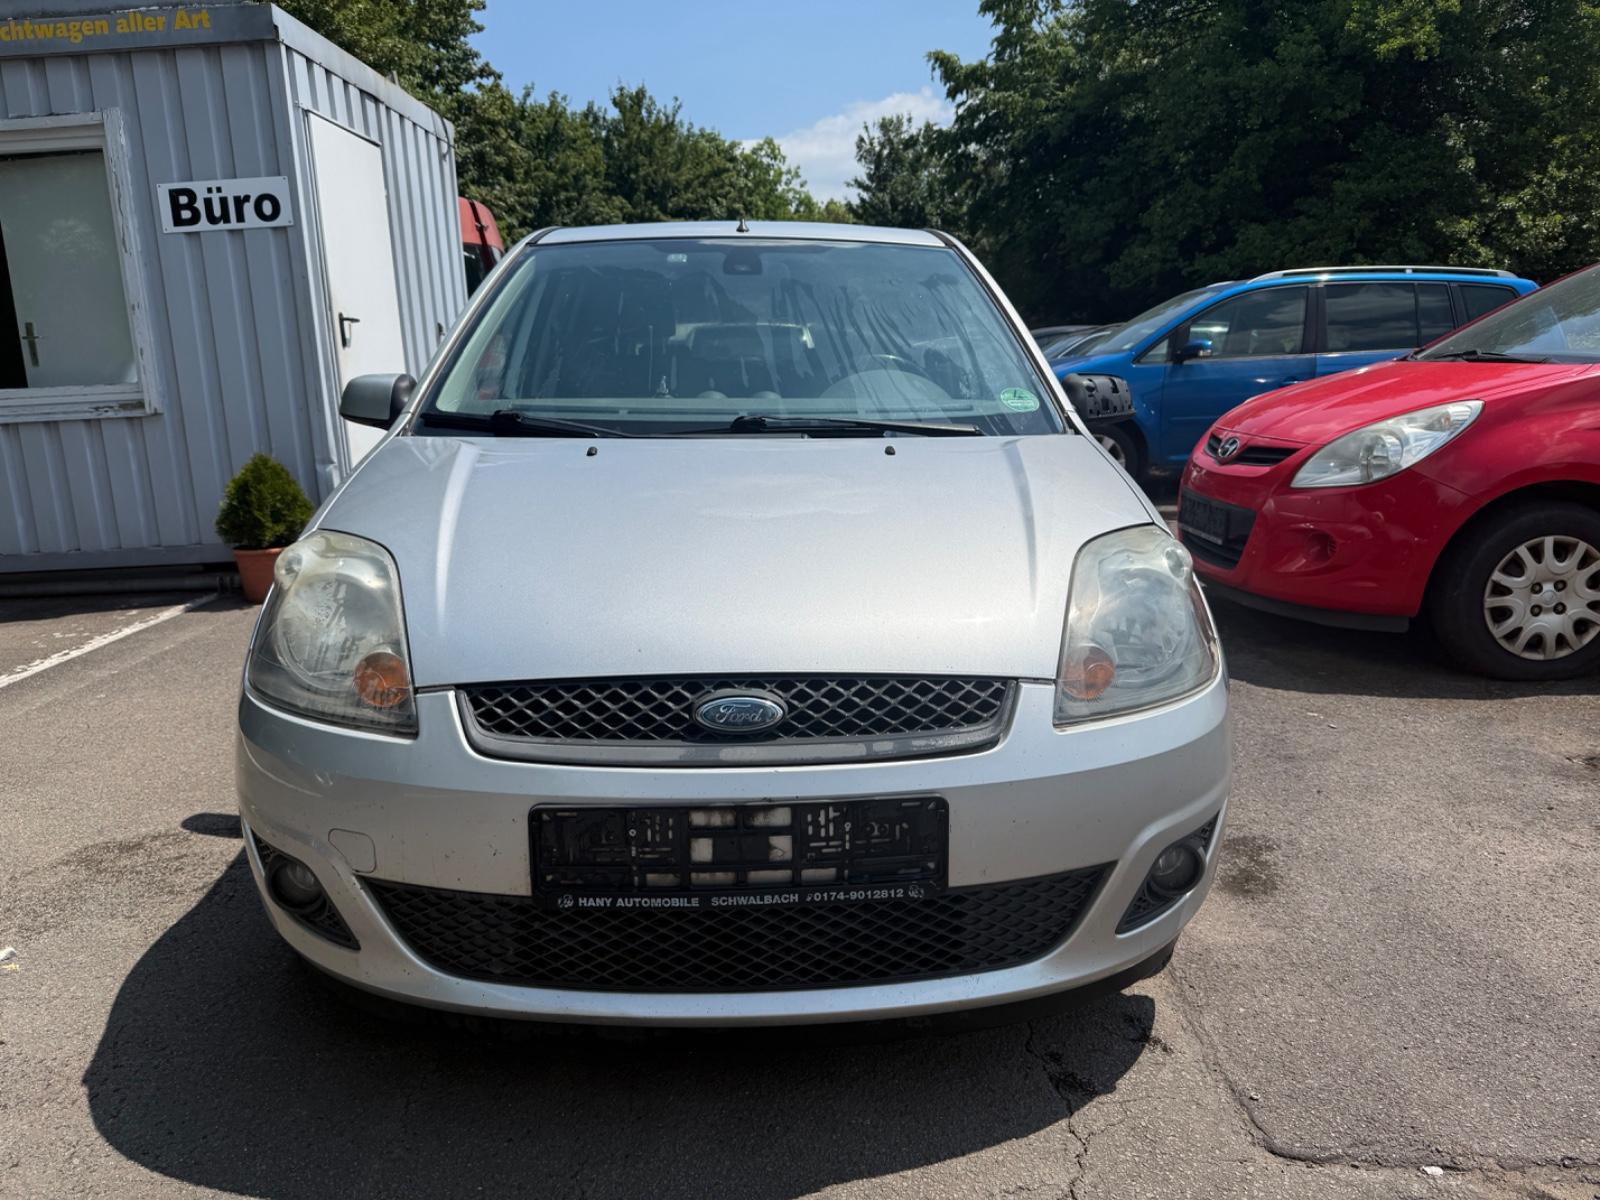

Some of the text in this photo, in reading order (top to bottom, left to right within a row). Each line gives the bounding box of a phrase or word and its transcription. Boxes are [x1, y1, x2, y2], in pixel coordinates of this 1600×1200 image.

[116, 11, 166, 33] aller
[174, 8, 211, 31] Art
[168, 186, 281, 227] Büro
[715, 704, 764, 723] Ford
[578, 889, 904, 908] HANY AUTOMOBILE SCHWALBACH 0174-9012812
